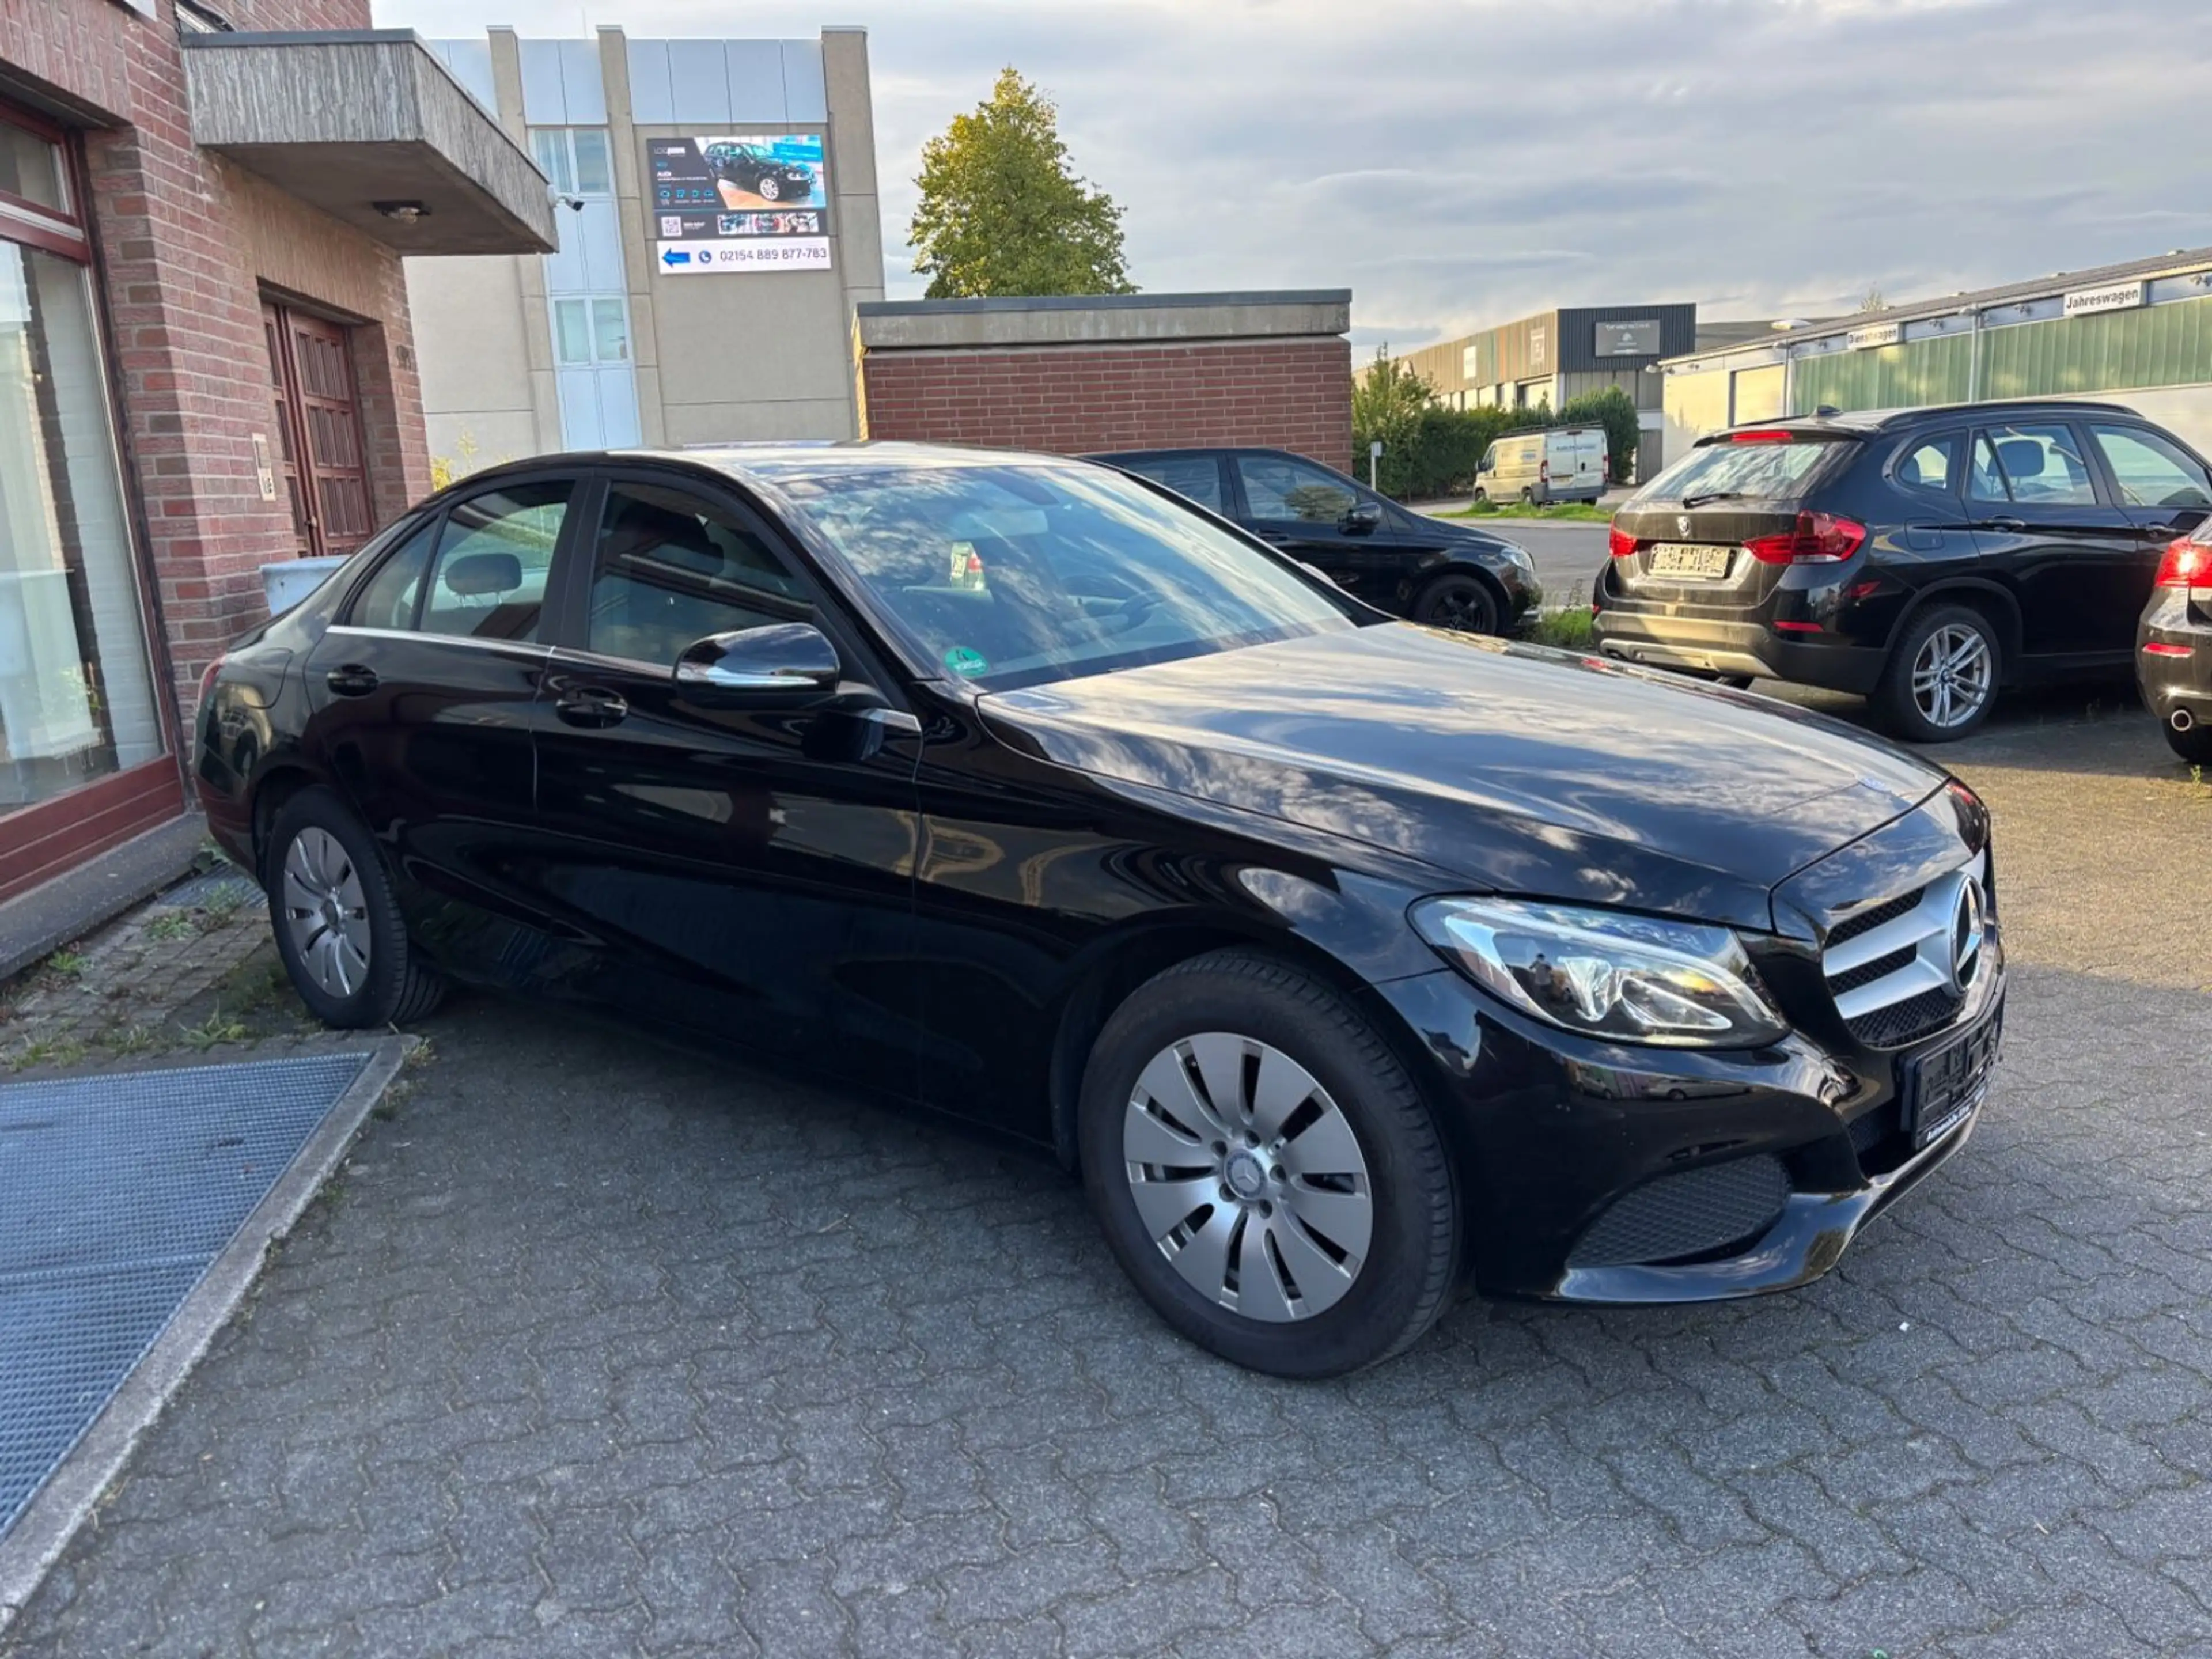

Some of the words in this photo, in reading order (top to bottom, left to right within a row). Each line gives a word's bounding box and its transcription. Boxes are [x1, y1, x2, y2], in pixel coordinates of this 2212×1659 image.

[720, 249, 754, 262] 02154
[757, 249, 778, 260] 889
[782, 247, 827, 259] 877-783
[2066, 289, 2139, 309] Jahreswagen
